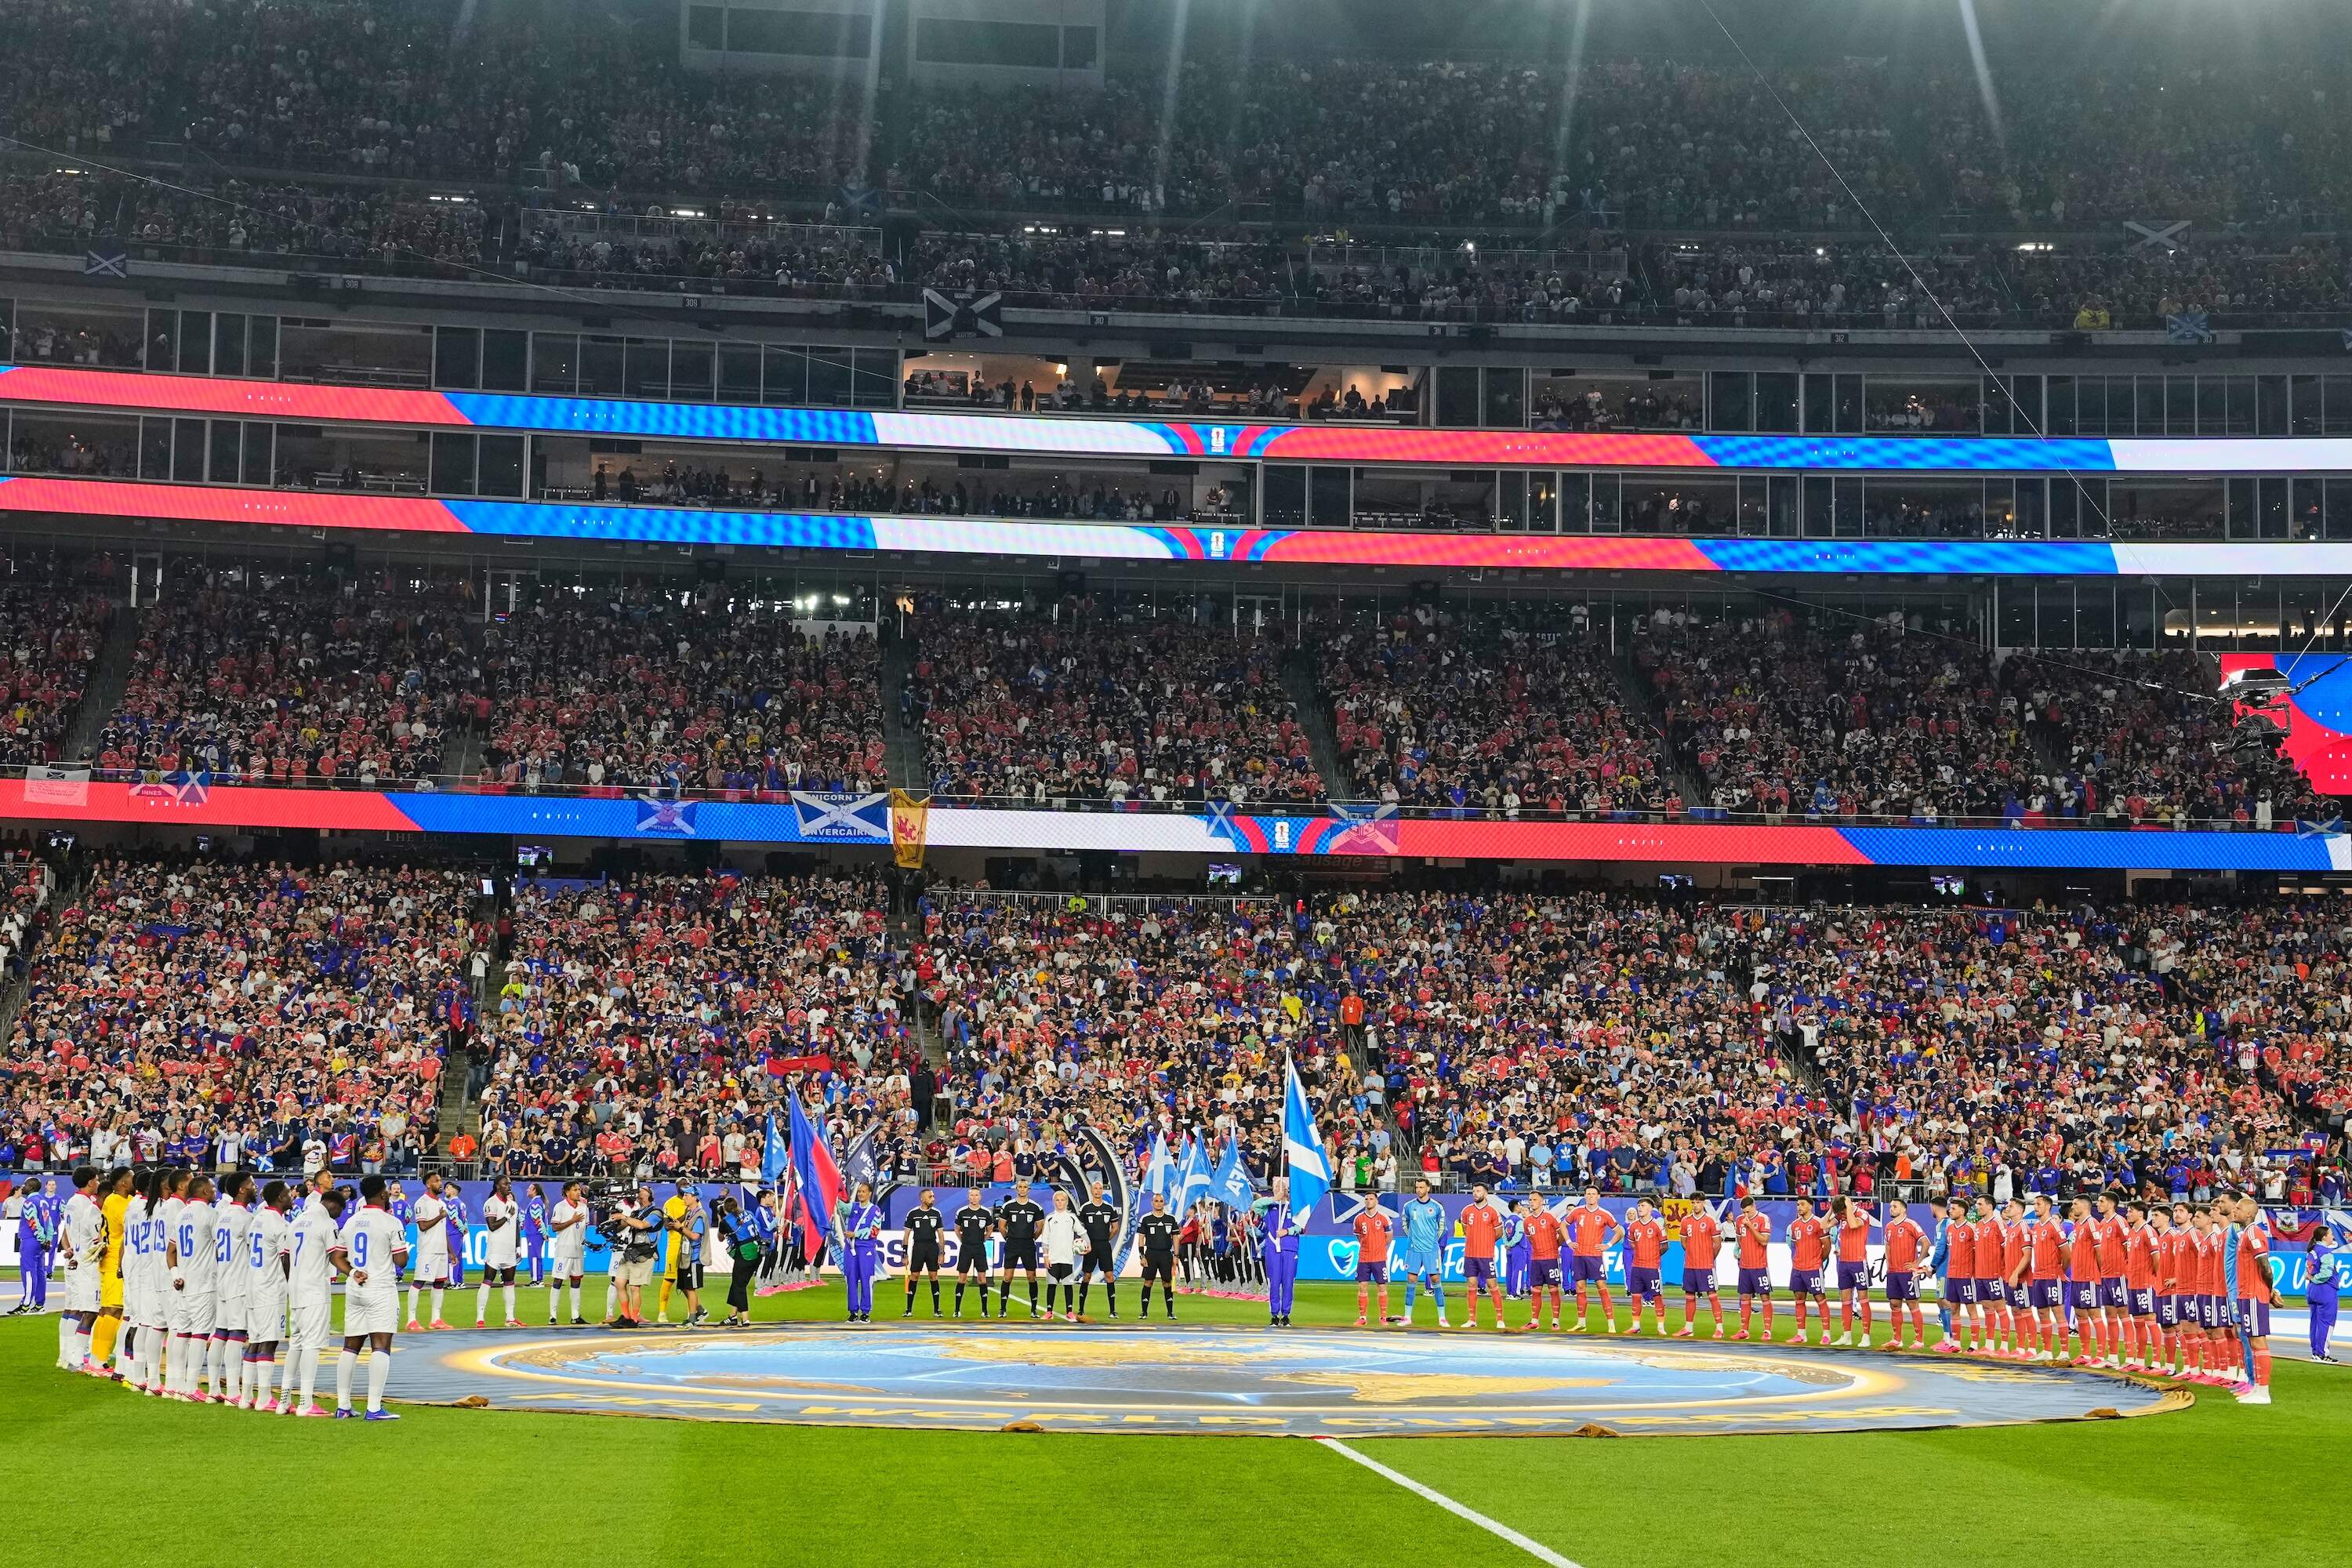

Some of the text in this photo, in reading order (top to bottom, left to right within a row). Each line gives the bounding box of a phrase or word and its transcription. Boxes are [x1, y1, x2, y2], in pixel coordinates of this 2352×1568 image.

[346, 280, 358, 289] 308
[1094, 316, 1104, 325] 310
[1835, 334, 1845, 343] 312
[1413, 1211, 1417, 1221] 1
[1468, 1216, 1474, 1225] 5
[1579, 1218, 1584, 1227] 4
[1362, 1225, 1367, 1235] 3
[1687, 1227, 1693, 1236] 2
[1794, 1230, 1802, 1240] 10
[179, 1225, 194, 1258] 16
[216, 1229, 231, 1261] 21
[295, 1232, 304, 1267] 7
[354, 1232, 368, 1268] 9
[424, 1264, 430, 1273] 5
[557, 1262, 562, 1271] 8
[1490, 1261, 1495, 1271] 5
[1382, 1267, 1387, 1277] 3
[1548, 1269, 1559, 1279] 20
[1708, 1275, 1714, 1285] 2
[1758, 1276, 1768, 1287] 19
[1809, 1277, 1820, 1287] 10
[1855, 1272, 1866, 1283] 13
[1650, 1279, 1660, 1290] 17
[1907, 1281, 1913, 1291] 7
[1989, 1281, 1999, 1291] 15
[1962, 1285, 1972, 1296] 11
[2013, 1290, 2024, 1301] 23
[2047, 1287, 2057, 1298] 16
[2080, 1290, 2090, 1301] 26
[2111, 1287, 2122, 1298] 14
[2136, 1293, 2147, 1305] 22
[2162, 1305, 2172, 1316] 25
[2184, 1301, 2195, 1313] 24
[2205, 1305, 2211, 1317] 6
[2220, 1305, 2227, 1316] 8
[2243, 1314, 2250, 1327] 9
